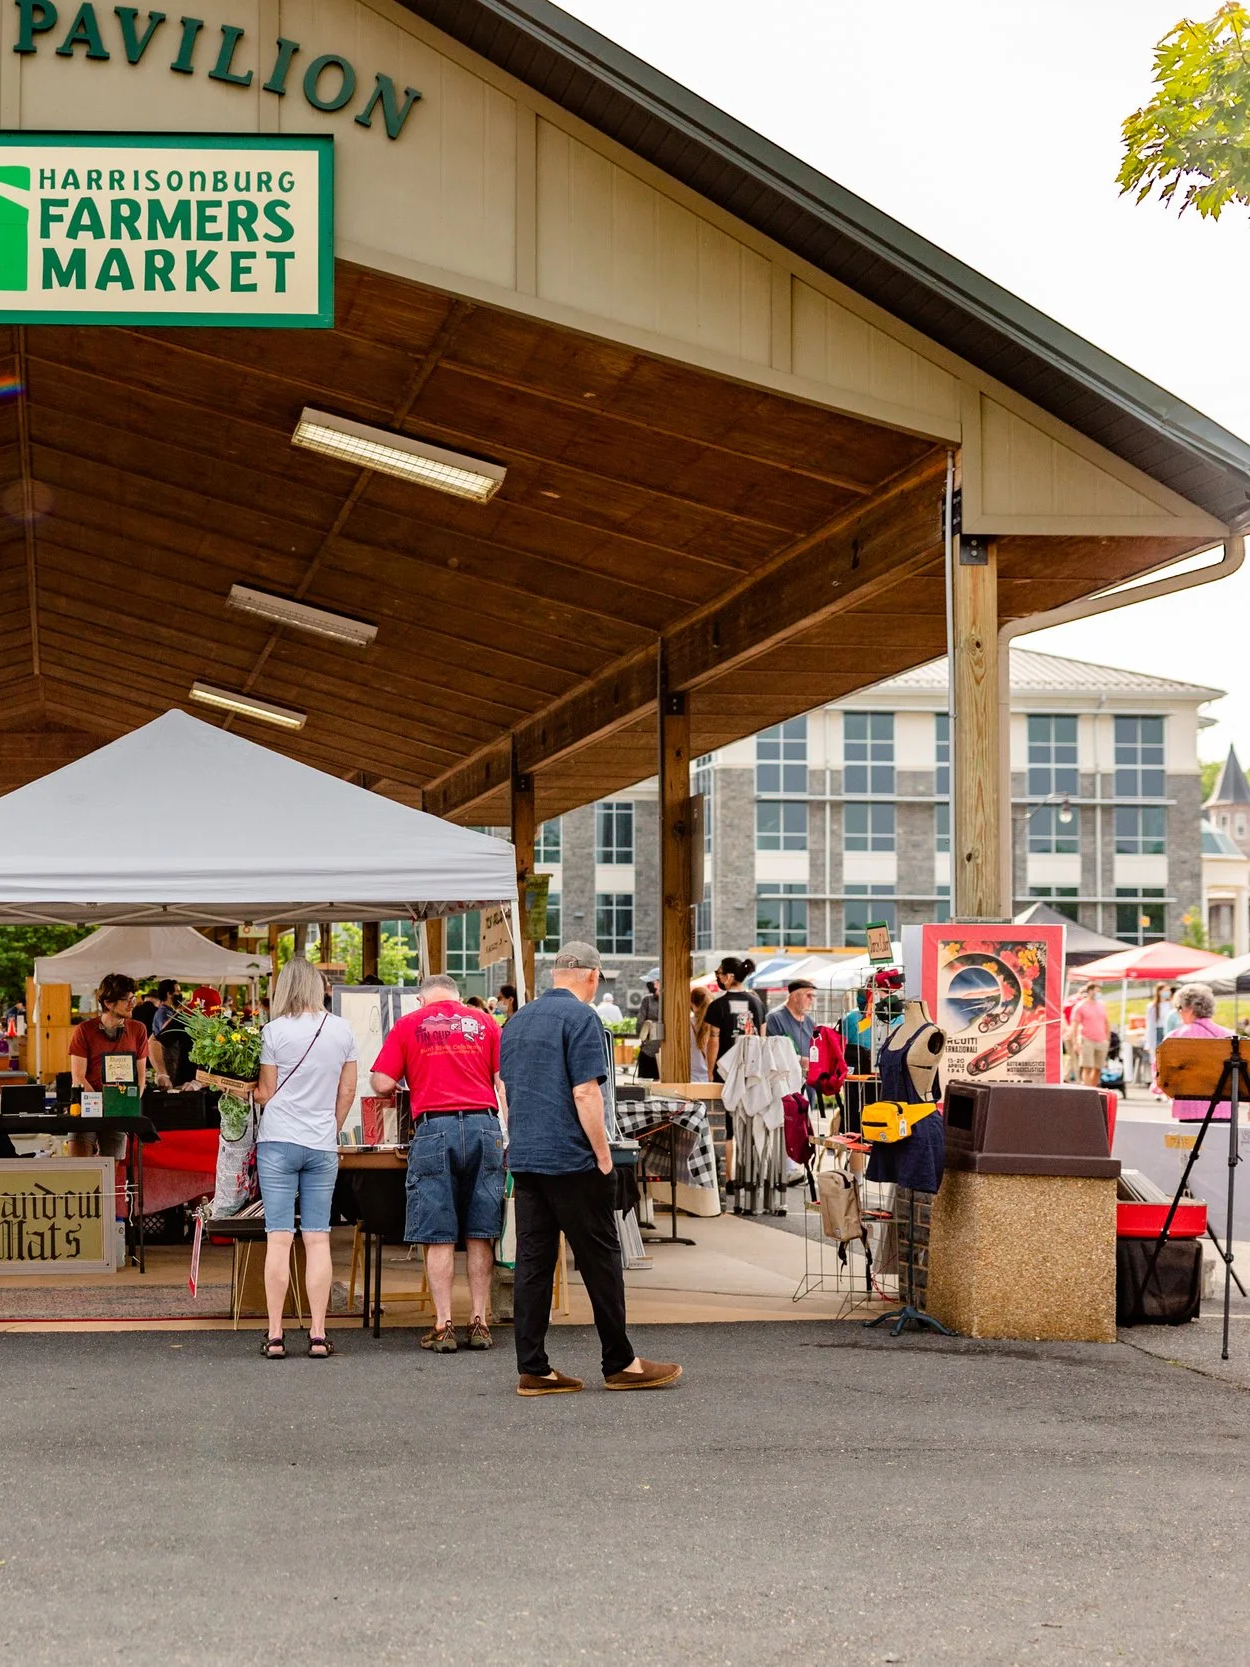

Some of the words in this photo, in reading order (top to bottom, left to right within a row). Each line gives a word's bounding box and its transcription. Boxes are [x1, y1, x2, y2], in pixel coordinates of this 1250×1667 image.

[13, 0, 422, 140] PAVILION
[38, 197, 296, 244] FARMERS
[41, 247, 296, 293] MARKET
[946, 1037, 978, 1045] RCUITI
